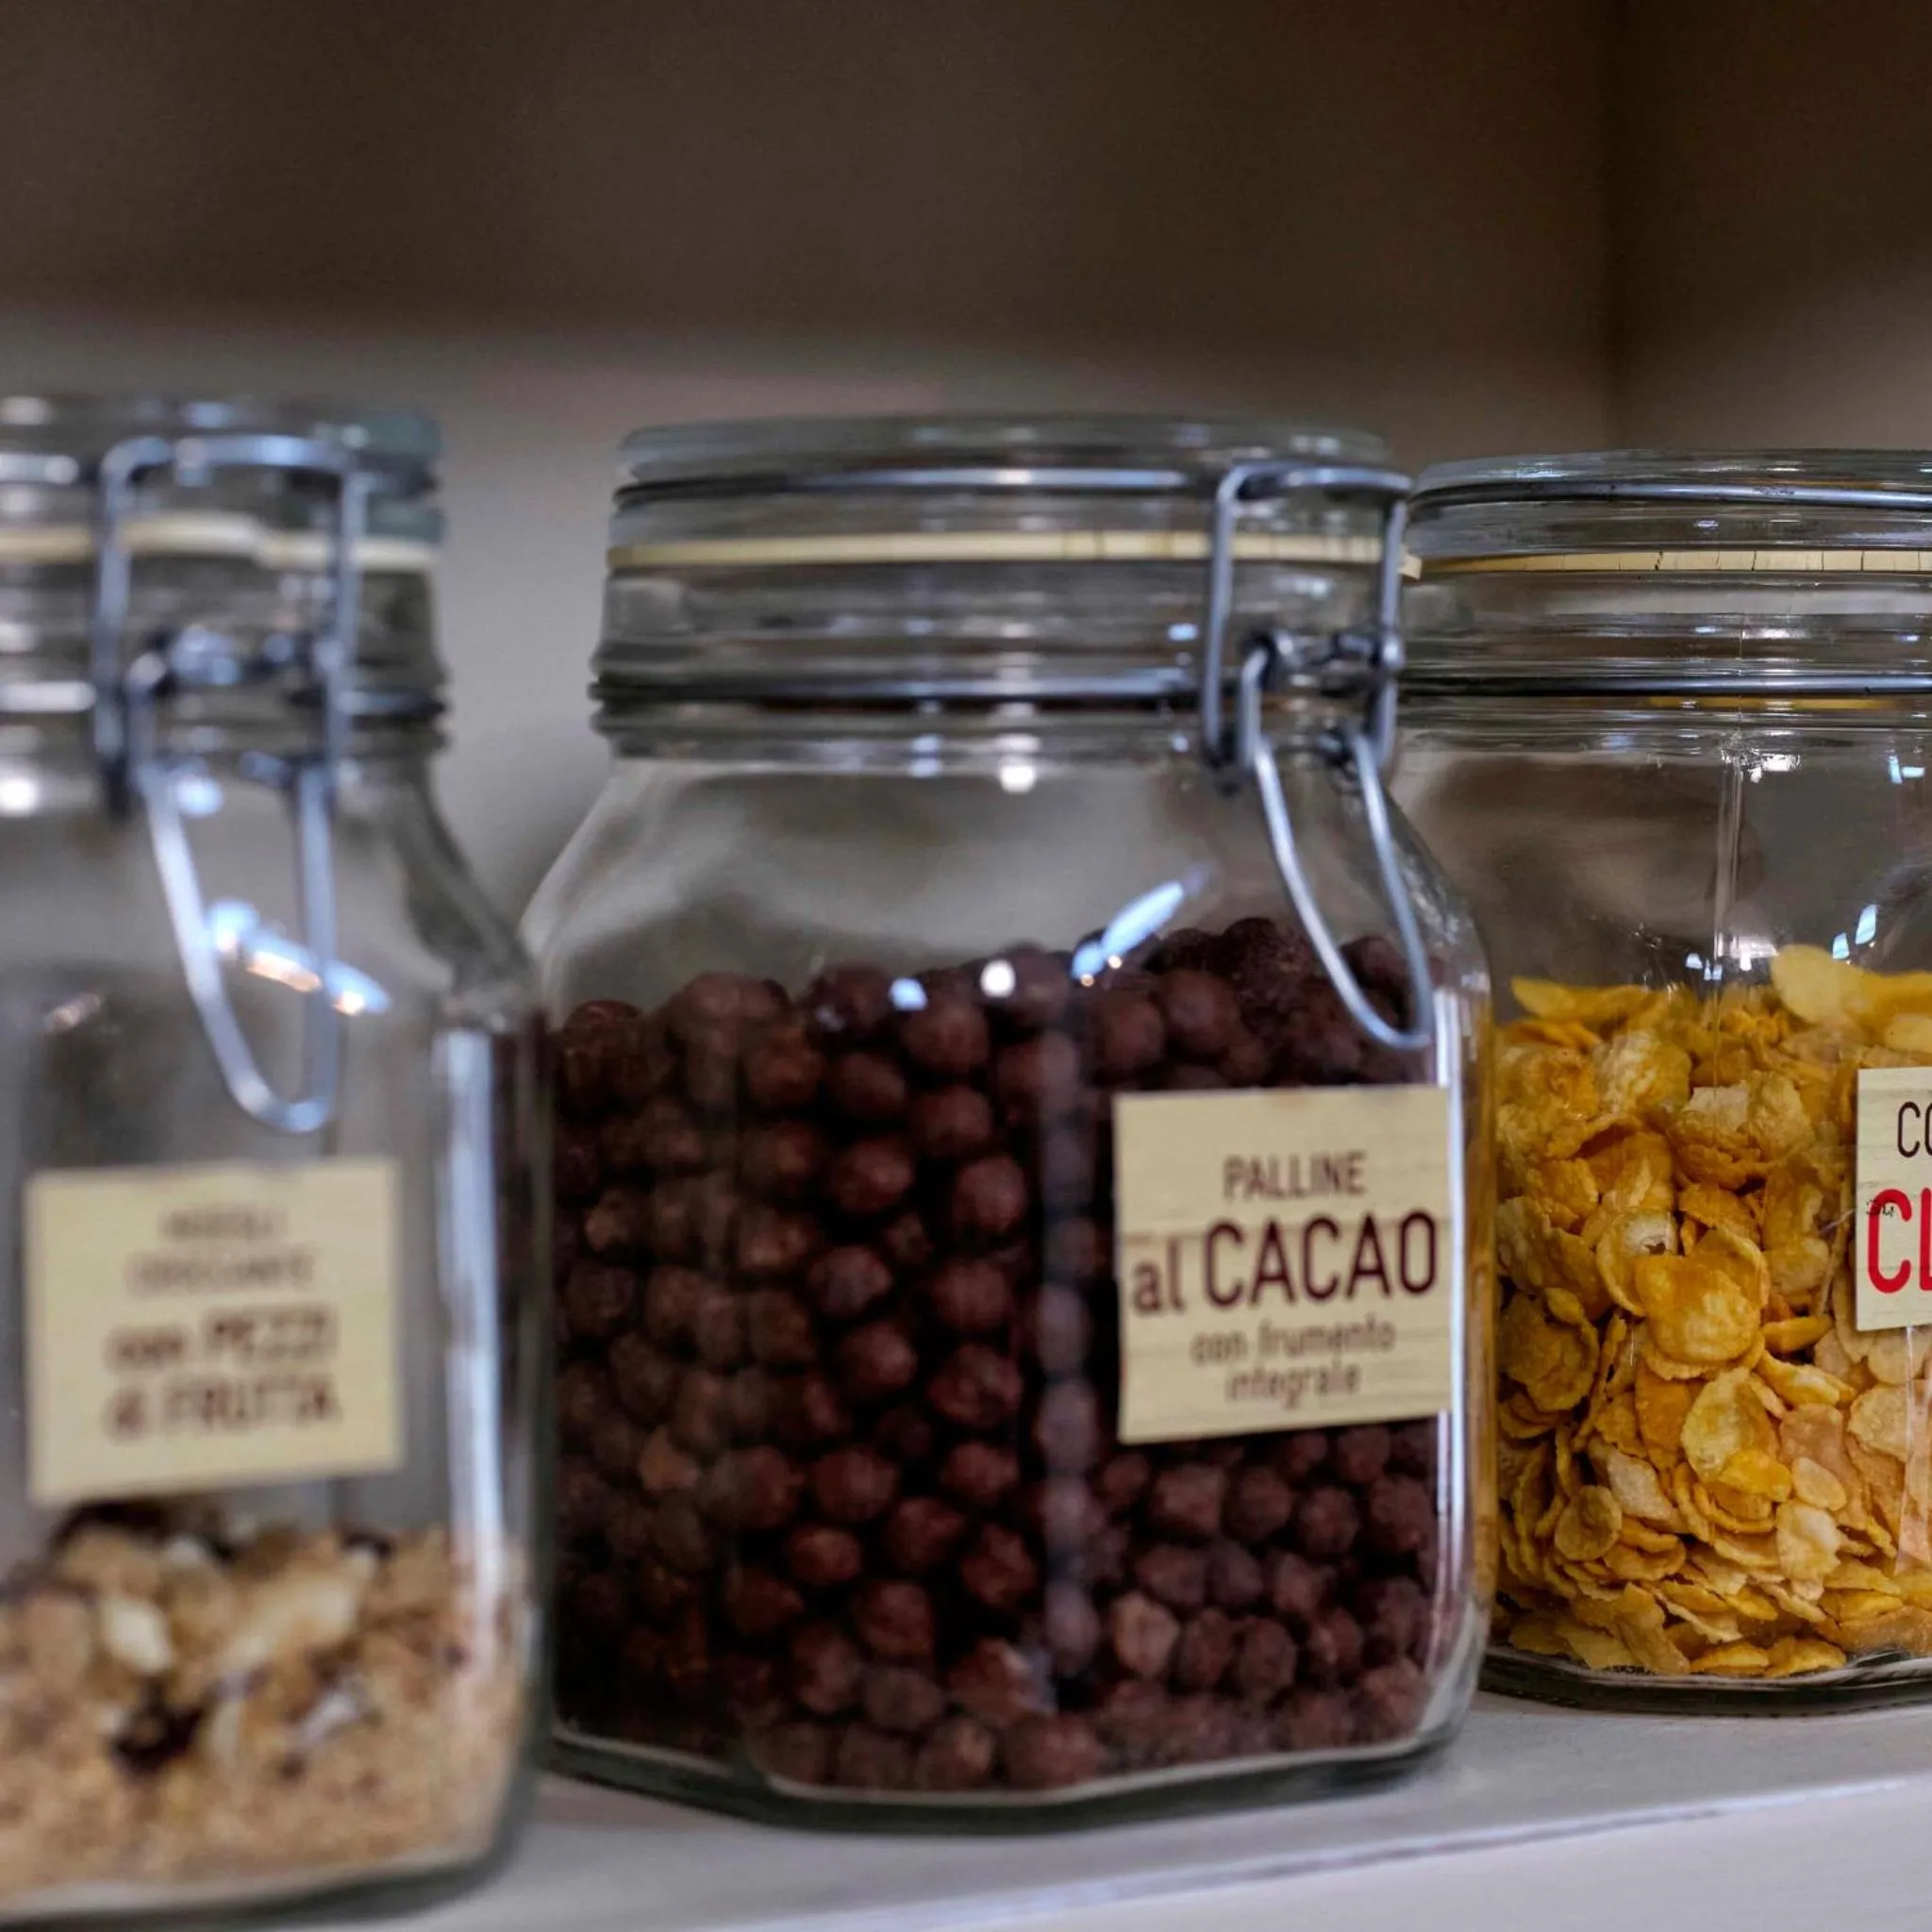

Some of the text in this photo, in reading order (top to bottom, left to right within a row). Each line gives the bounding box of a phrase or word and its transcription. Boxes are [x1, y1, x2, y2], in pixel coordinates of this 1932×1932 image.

[1224, 1150, 1367, 1200] PALLINE
[1133, 1209, 1438, 1314] al CACAO
